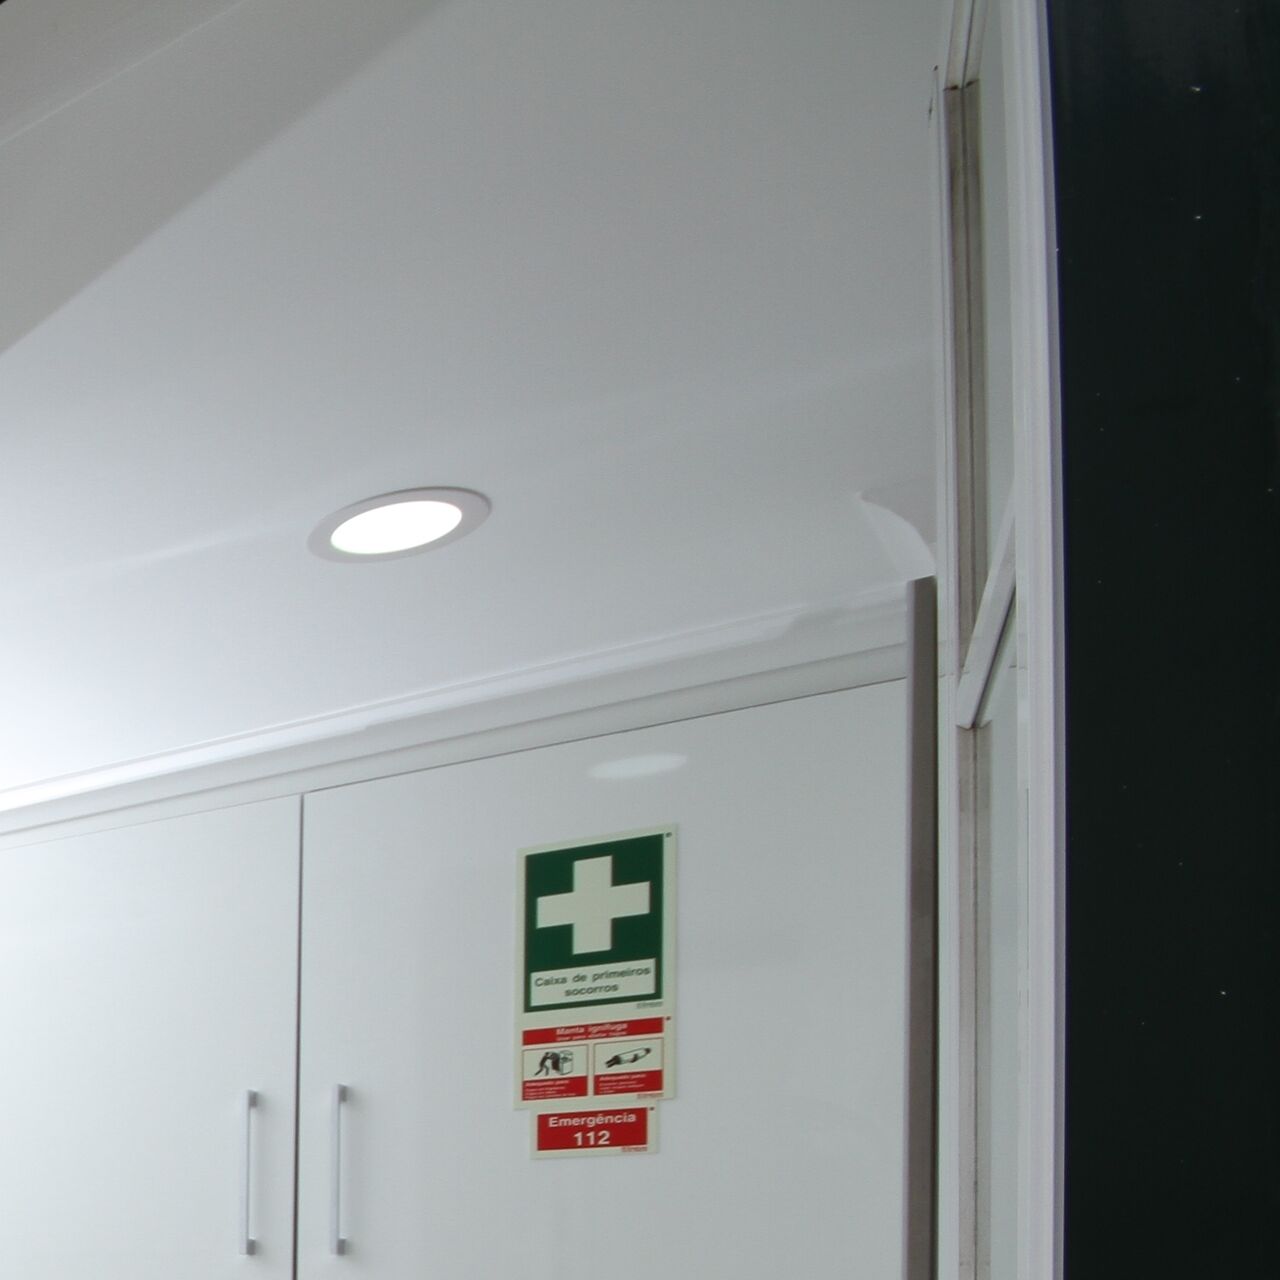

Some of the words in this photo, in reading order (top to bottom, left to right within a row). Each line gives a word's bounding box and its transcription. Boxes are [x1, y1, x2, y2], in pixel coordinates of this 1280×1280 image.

[534, 976, 568, 988] Caixa
[572, 973, 587, 983] de
[592, 966, 651, 982] primeiros
[564, 983, 619, 997] socorros
[548, 1112, 637, 1128] Emergência
[573, 1130, 611, 1147] 112
